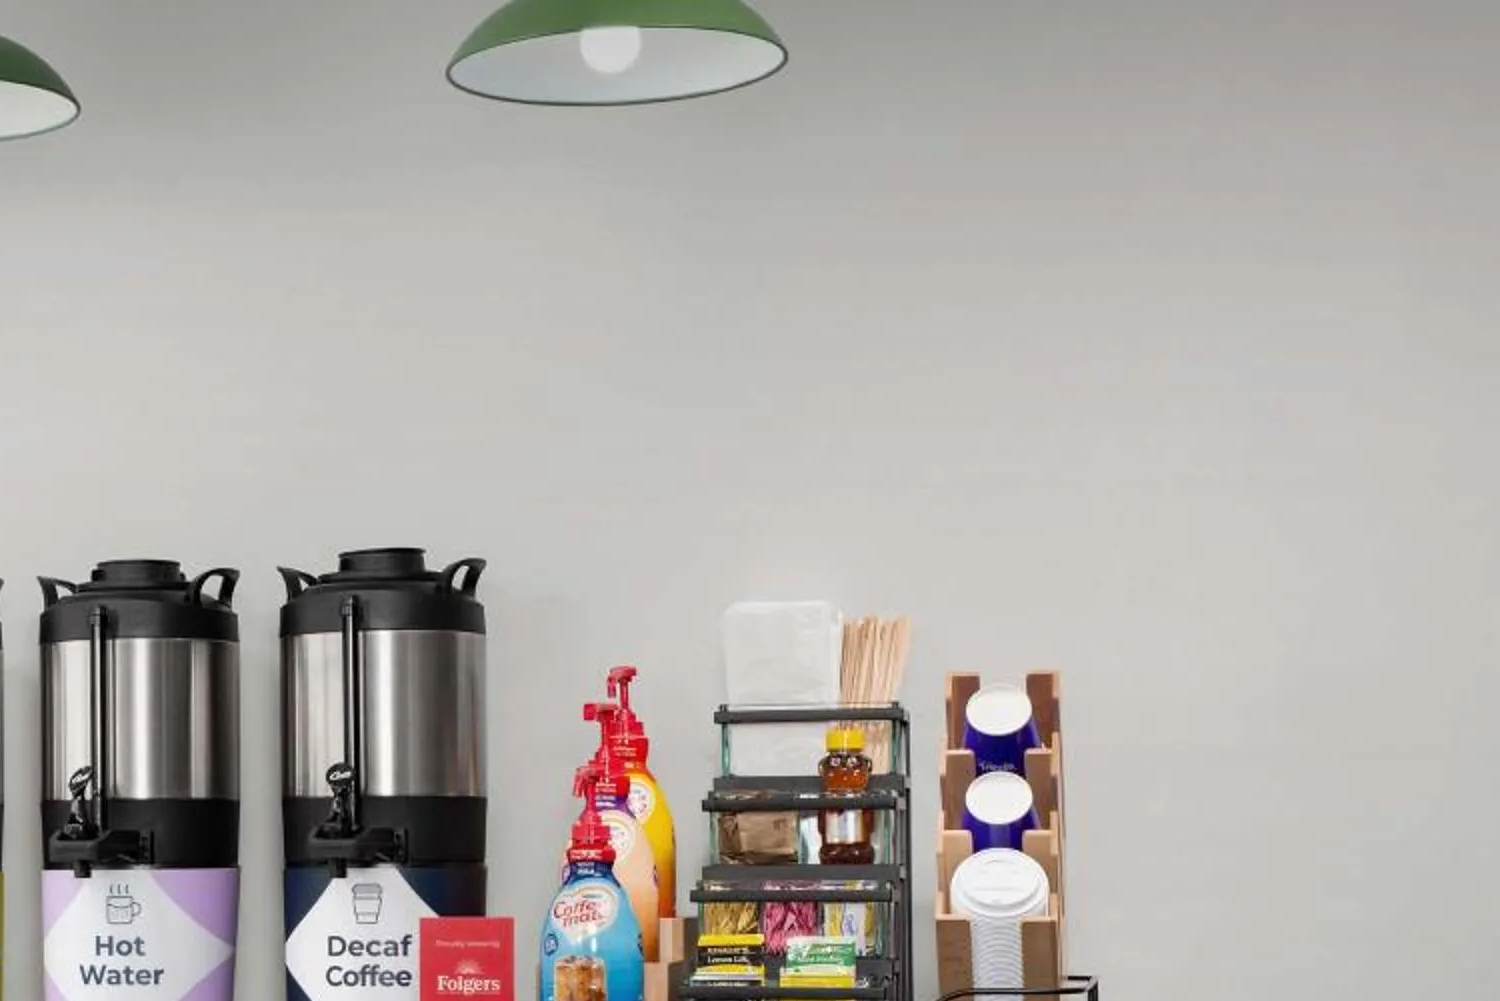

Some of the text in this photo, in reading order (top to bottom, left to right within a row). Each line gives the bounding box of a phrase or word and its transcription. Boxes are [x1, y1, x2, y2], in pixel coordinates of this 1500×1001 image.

[552, 899, 605, 919] Coffe
[94, 935, 146, 957] Hot
[327, 934, 413, 957] Decaf
[79, 964, 165, 986] Water
[325, 964, 413, 987] Coffee
[436, 975, 501, 996] Folgers
